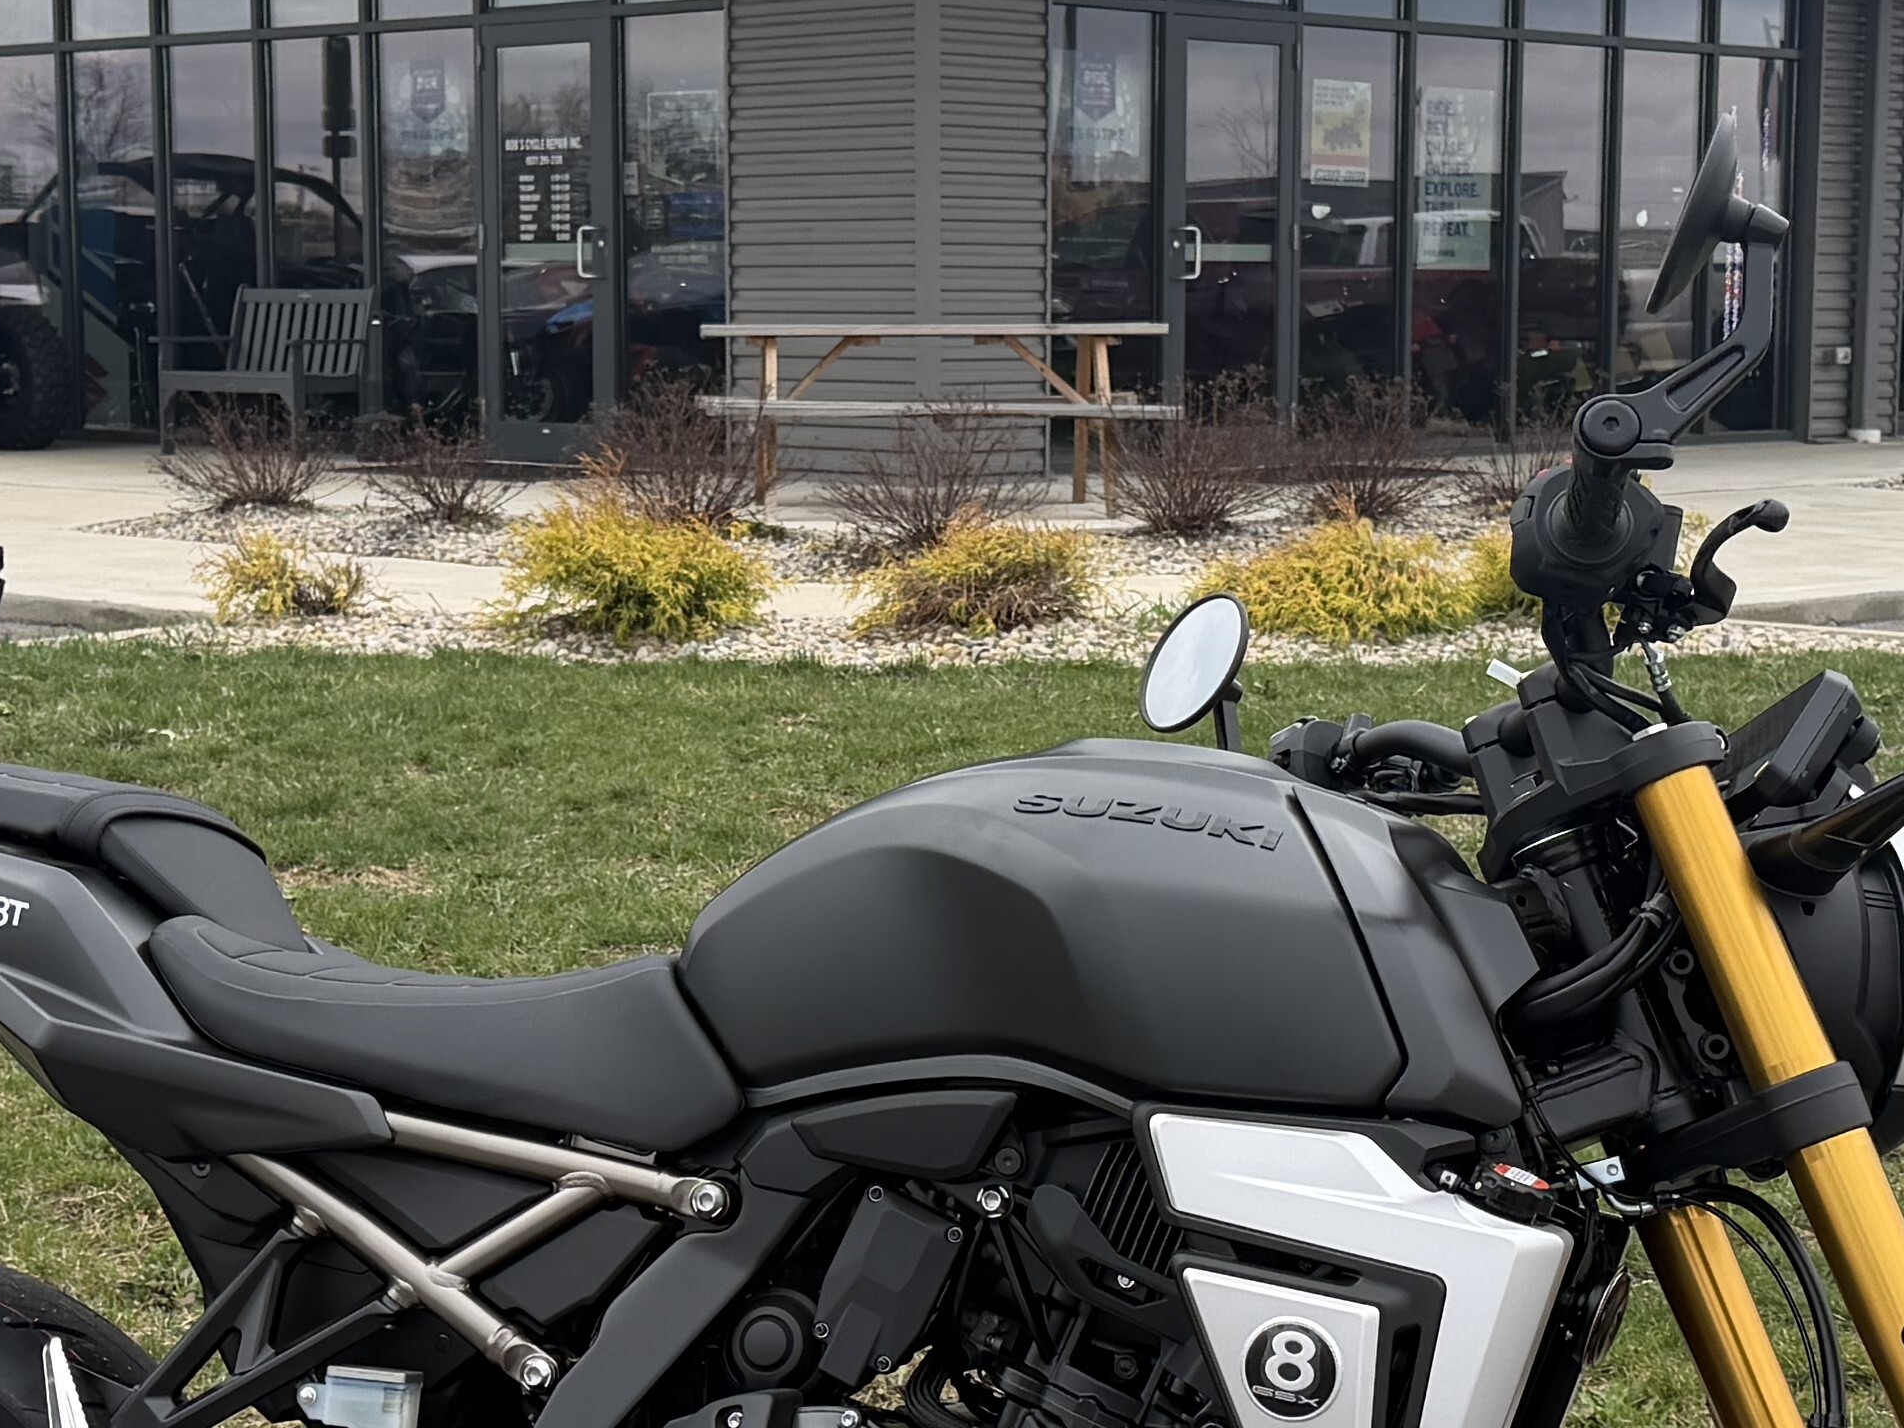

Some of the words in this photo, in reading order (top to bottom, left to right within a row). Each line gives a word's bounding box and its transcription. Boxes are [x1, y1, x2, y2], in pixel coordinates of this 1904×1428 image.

[1425, 181, 1479, 197] EXPLORE.
[1013, 795, 1283, 852] SUZUKI
[1265, 1330, 1316, 1392] 8
[1252, 1385, 1320, 1407] GSX
